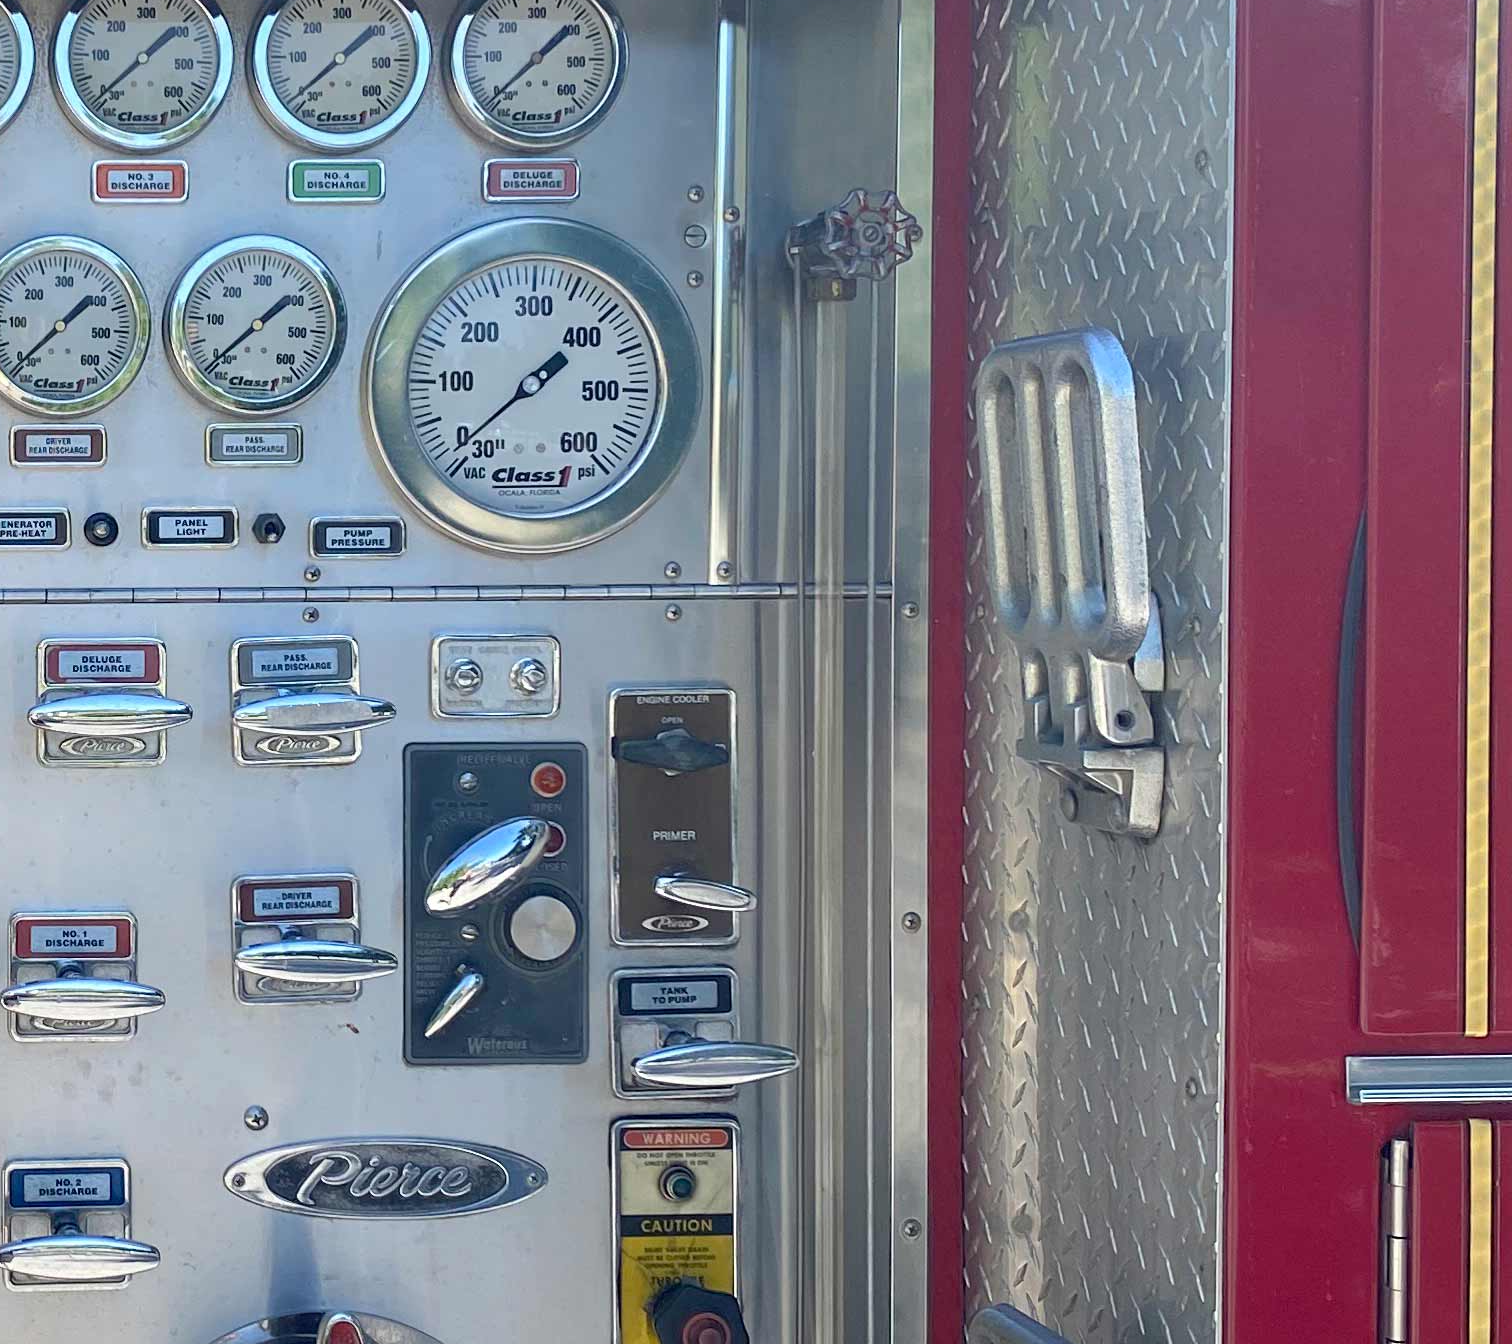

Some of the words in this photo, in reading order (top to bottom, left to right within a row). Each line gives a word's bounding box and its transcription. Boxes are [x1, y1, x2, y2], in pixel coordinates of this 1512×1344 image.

[128, 173, 144, 181] NO.
[513, 171, 553, 179] DELUGE
[111, 182, 170, 190] DISCHARGE
[307, 181, 366, 189] DISCHARGE
[503, 180, 562, 188] DISCHARGE
[514, 295, 554, 317] 300
[460, 322, 500, 344] 200
[562, 327, 601, 347] 400
[438, 371, 475, 392] 100
[581, 380, 620, 401] 500
[559, 432, 599, 453] 600
[463, 465, 486, 480] VAC
[577, 465, 597, 481] psi
[175, 519, 208, 527] PANEL
[177, 528, 205, 536] LIGHT
[637, 696, 669, 704] ENGINE
[673, 695, 710, 703] COOLER
[653, 831, 696, 840] PRIMER
[62, 930, 78, 938] NO.
[45, 939, 104, 947] DISCHARGE
[643, 1133, 710, 1144] WARNING
[297, 1151, 473, 1205] Pierce
[55, 1179, 72, 1187] NO.
[39, 1188, 98, 1196] DISCHARGE
[641, 1219, 713, 1232] CAUTION
